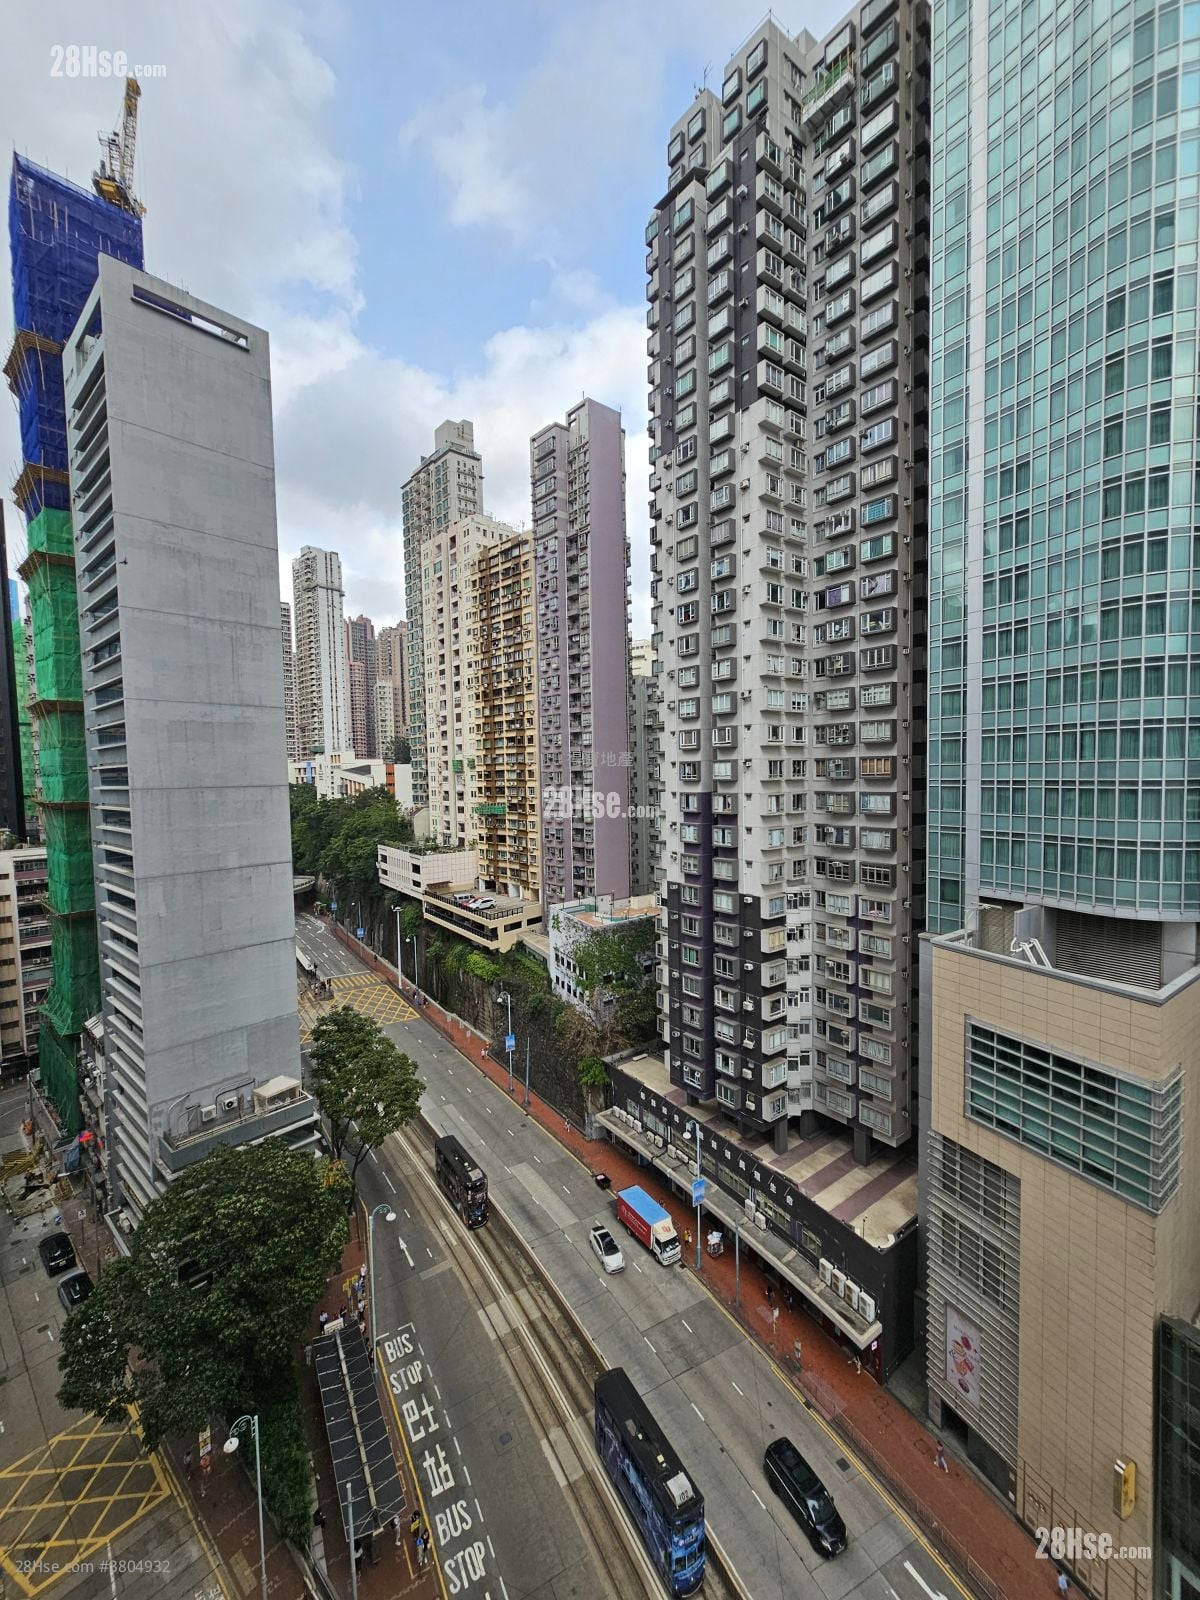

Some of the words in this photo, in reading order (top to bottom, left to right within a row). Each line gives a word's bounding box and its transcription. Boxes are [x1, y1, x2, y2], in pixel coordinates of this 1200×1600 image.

[384, 1333, 414, 1363] BUS
[389, 1360, 423, 1395] STOP
[401, 1393, 440, 1443] 巴士
[422, 1443, 456, 1498] 站
[435, 1499, 473, 1547] BUS
[444, 1541, 487, 1595] STOP
